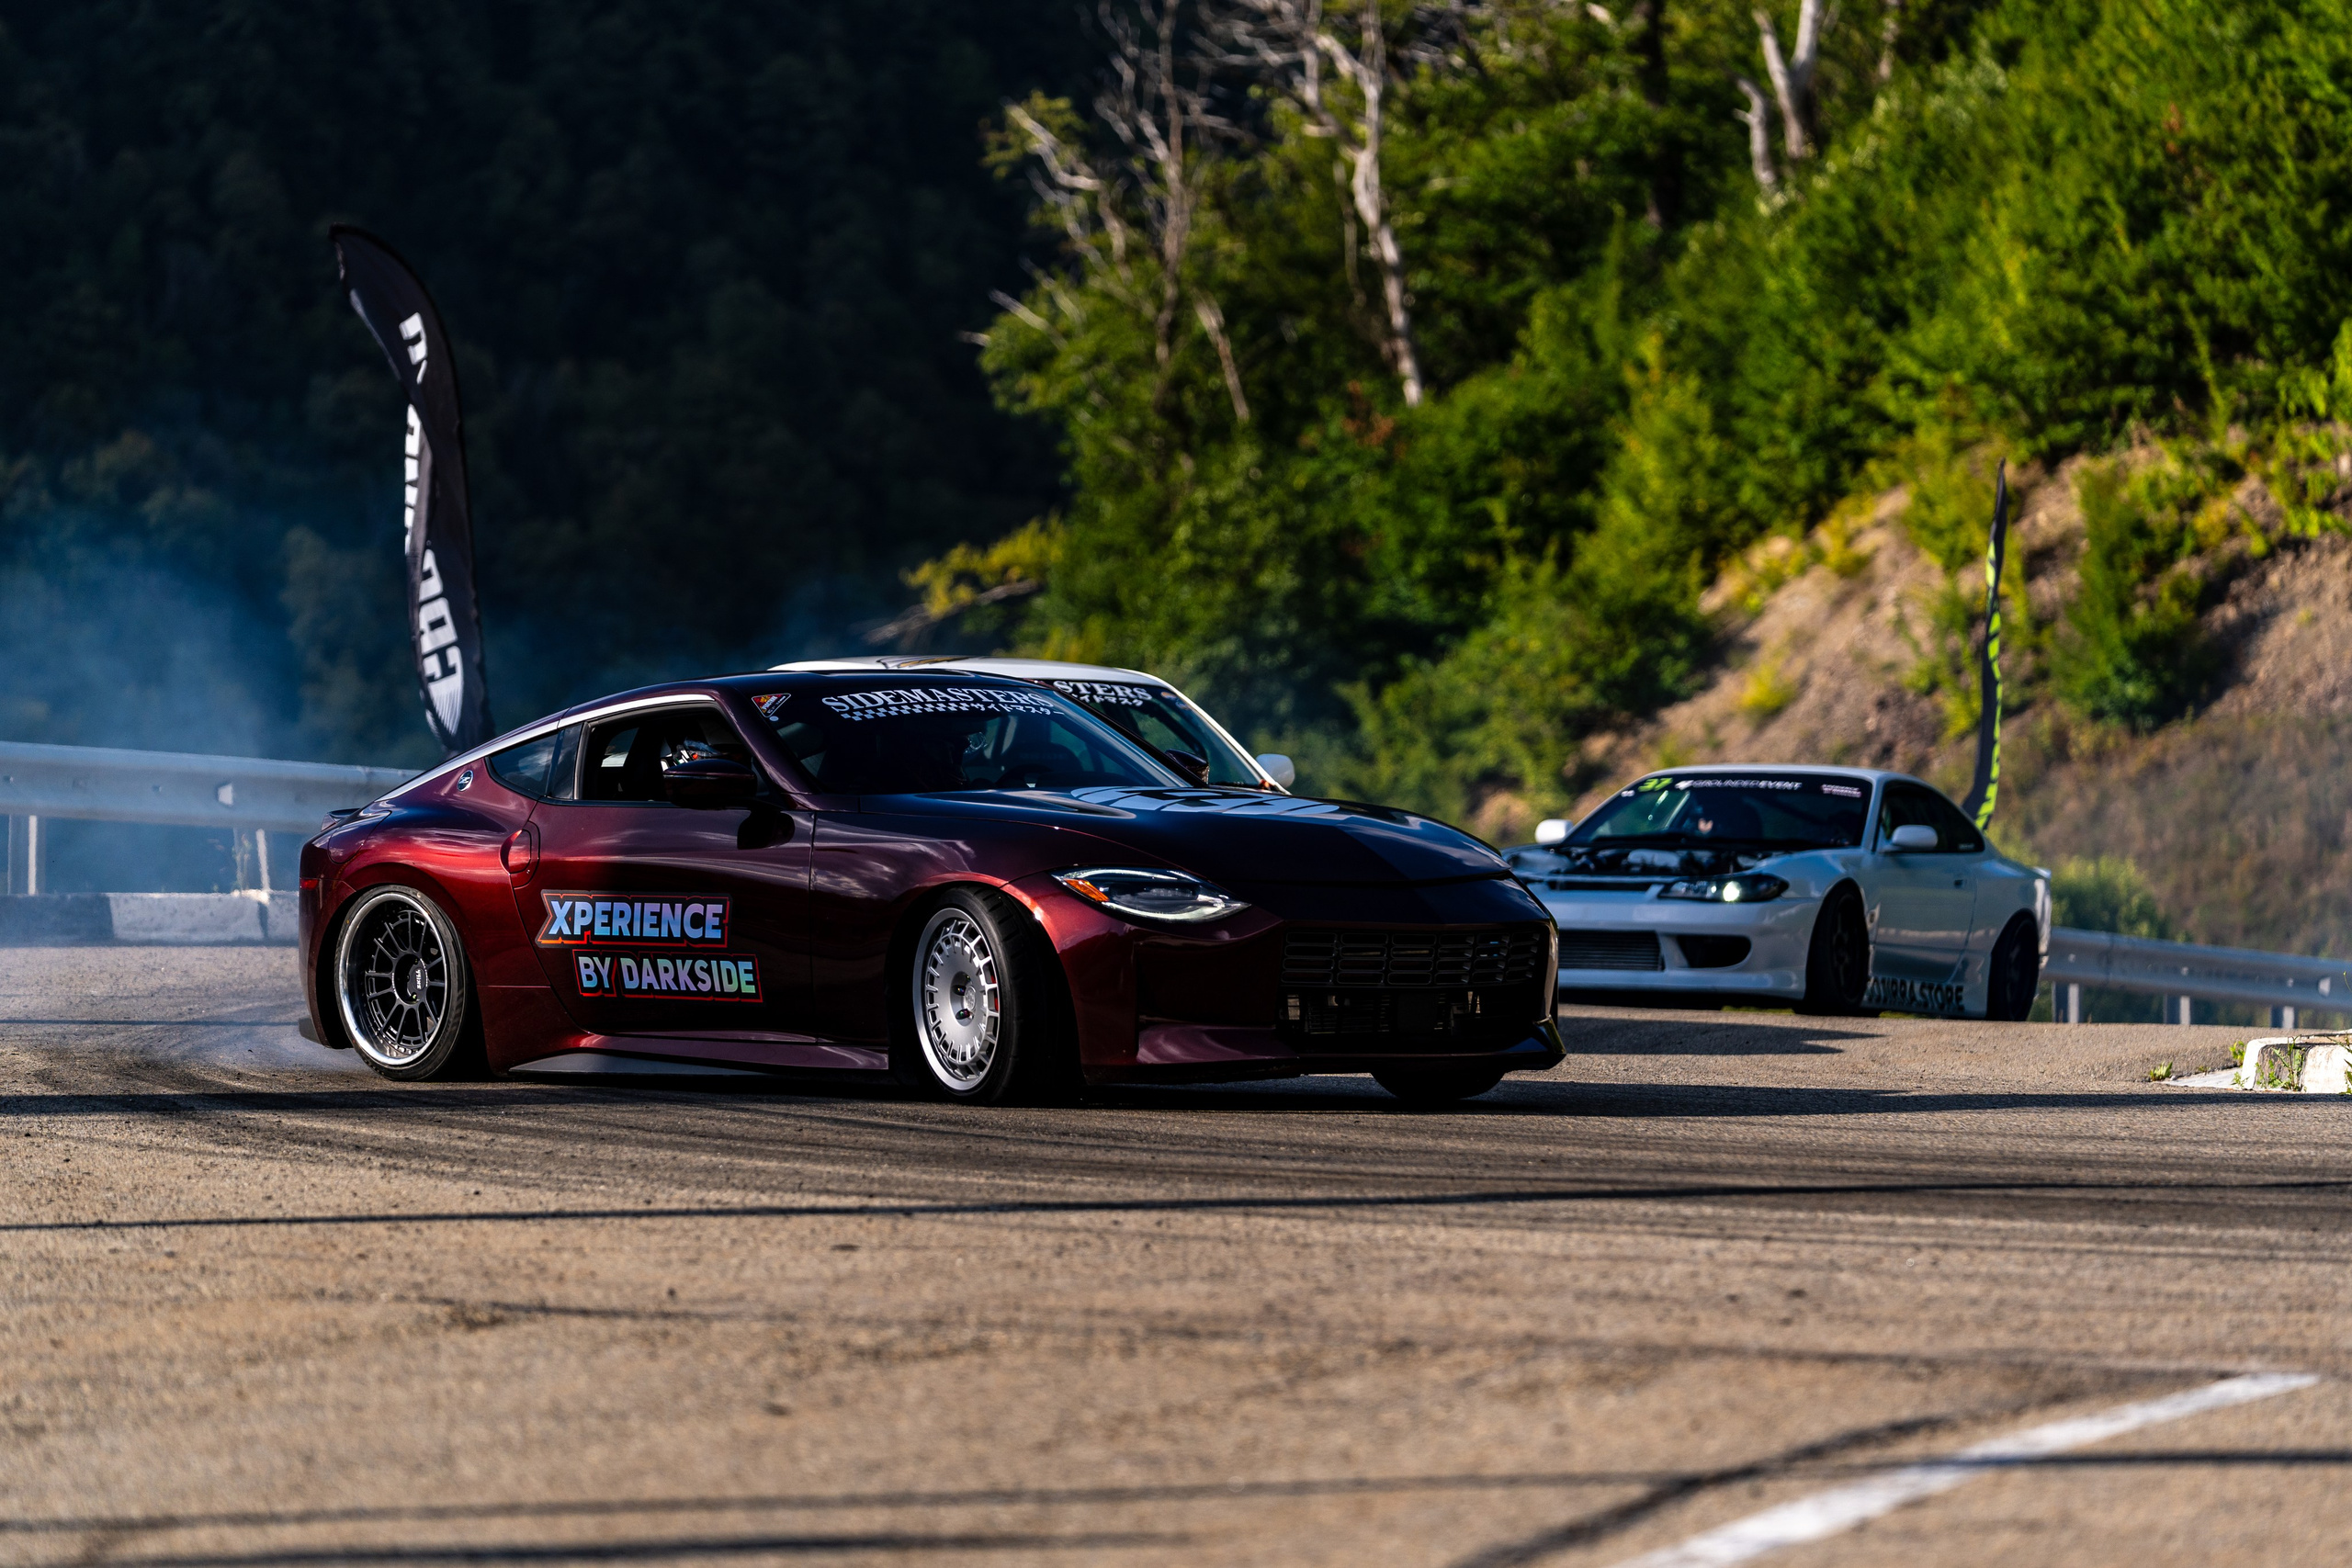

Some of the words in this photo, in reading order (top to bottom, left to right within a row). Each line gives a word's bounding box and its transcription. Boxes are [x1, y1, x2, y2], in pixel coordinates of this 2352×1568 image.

[821, 687, 1055, 712] SIDEMASTERS
[548, 900, 723, 939] XPERIENCE
[578, 956, 611, 988] BY
[620, 957, 756, 993] DARKSIDE
